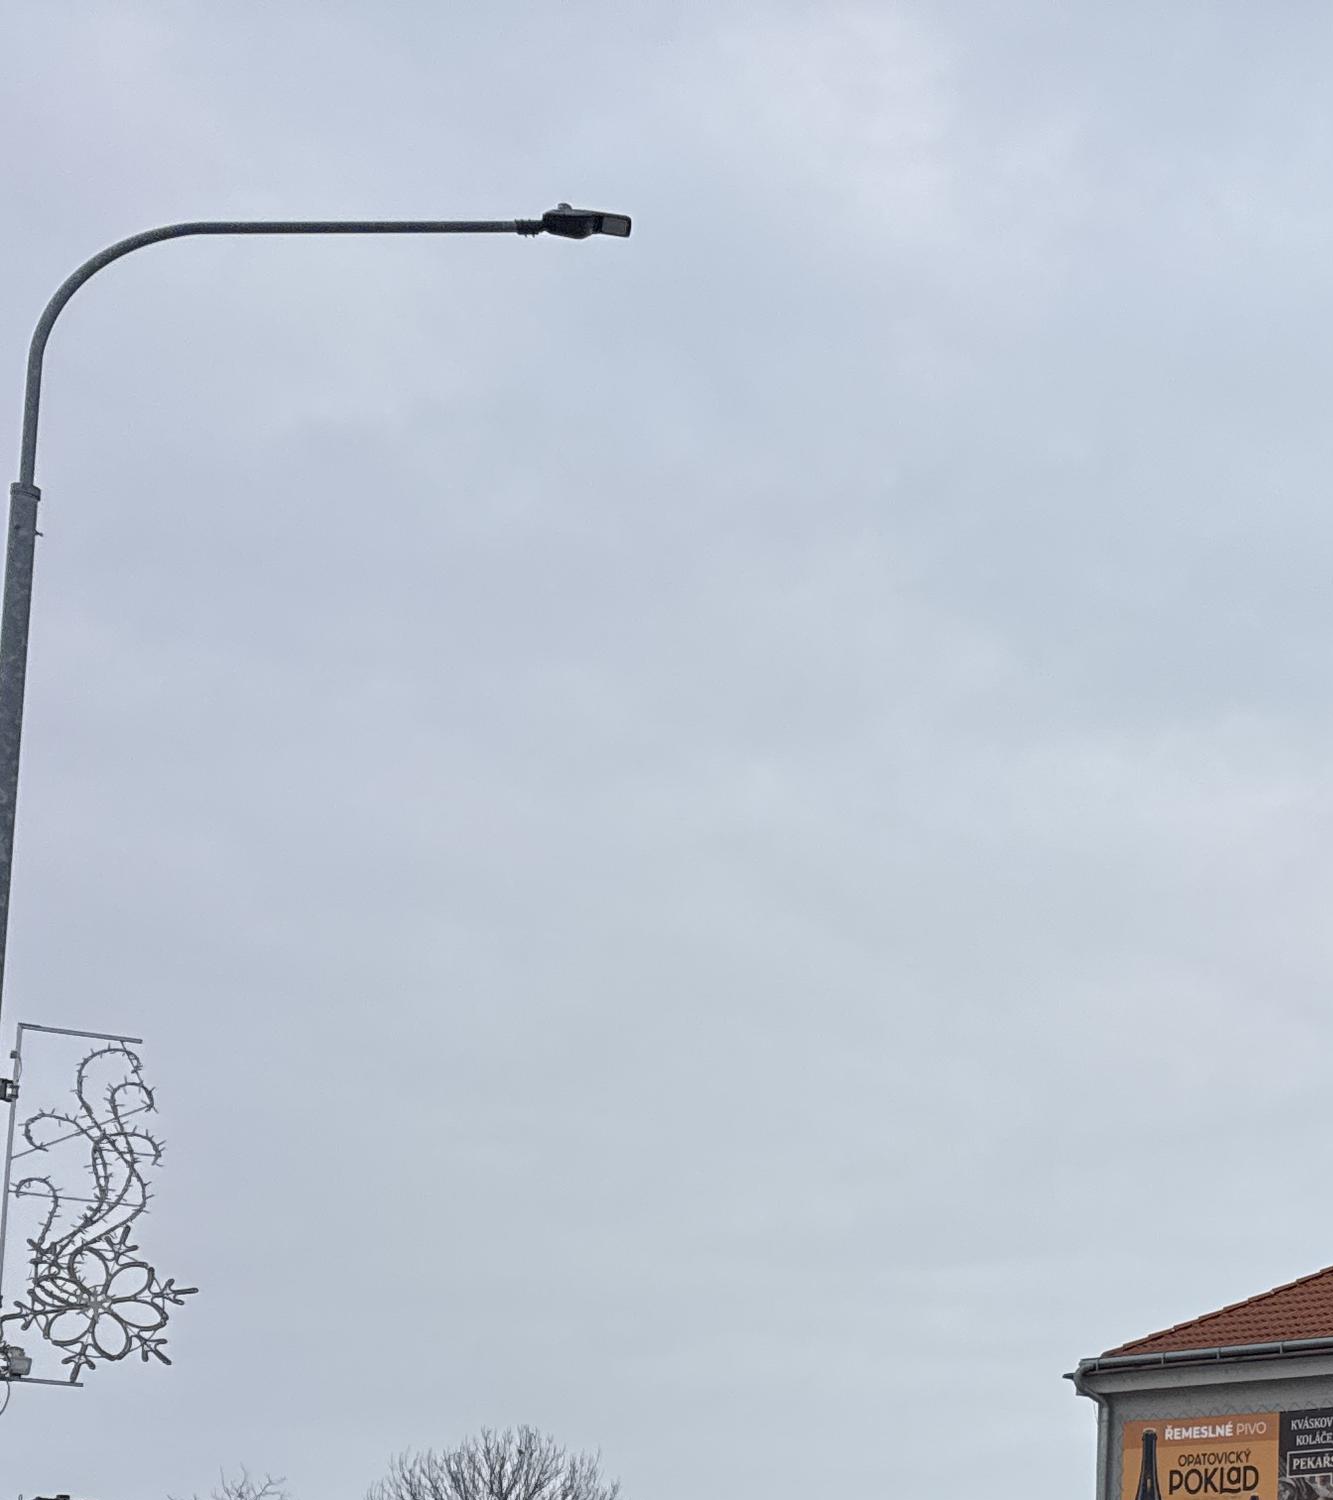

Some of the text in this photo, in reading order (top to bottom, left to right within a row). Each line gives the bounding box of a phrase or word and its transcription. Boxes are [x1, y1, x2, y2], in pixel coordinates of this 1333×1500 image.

[1164, 1421, 1267, 1441] ŘEMESLNÉ PIVO
[1178, 1448, 1251, 1467] OPATOVICKÝ
